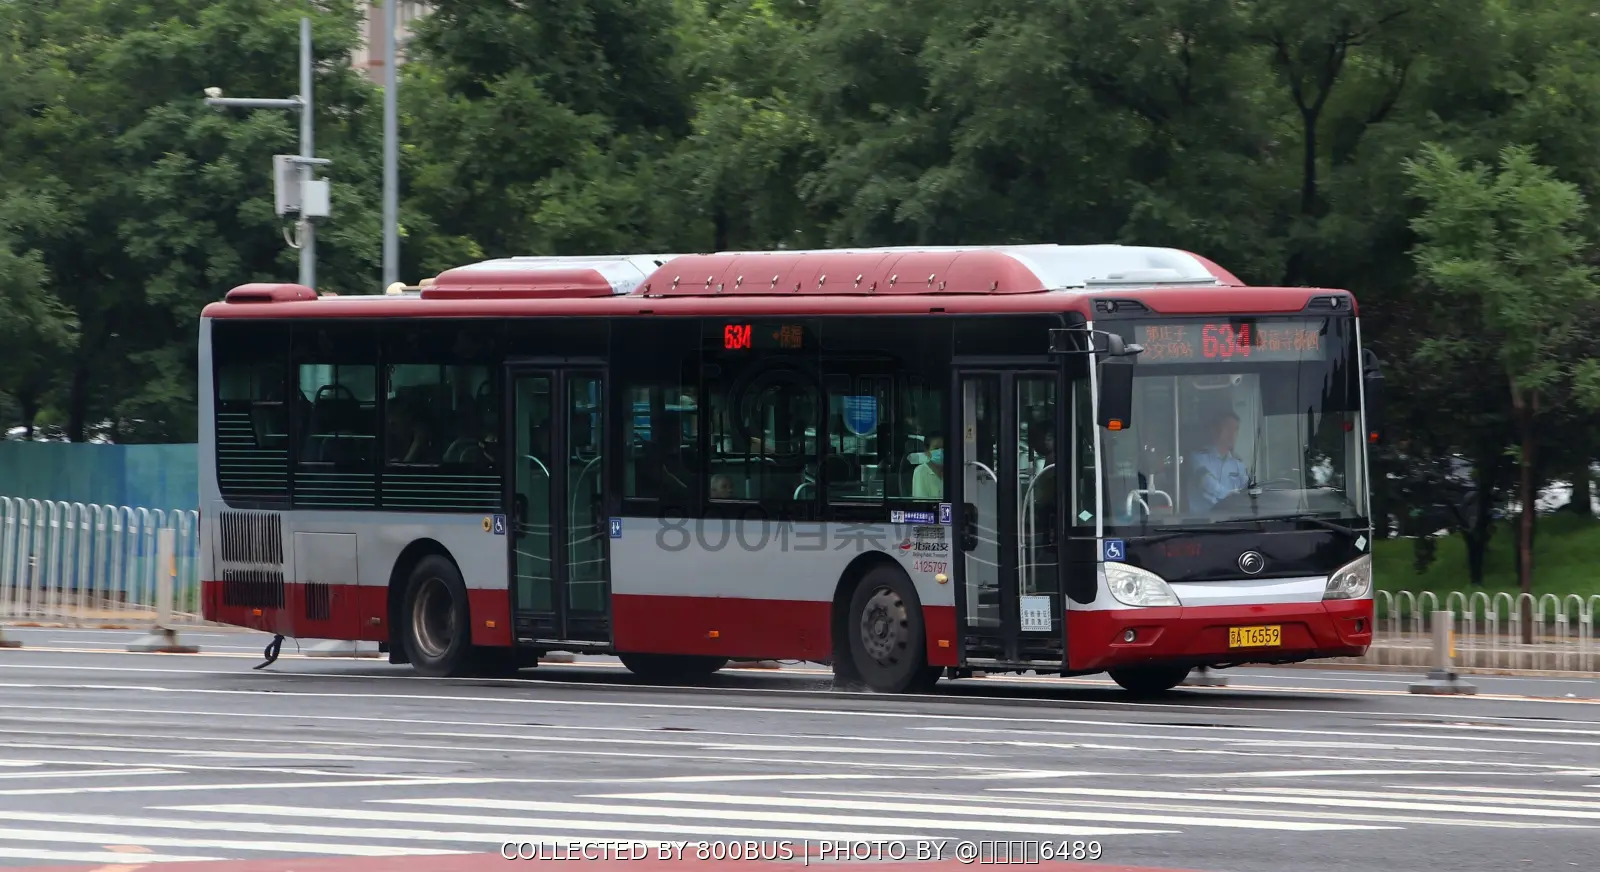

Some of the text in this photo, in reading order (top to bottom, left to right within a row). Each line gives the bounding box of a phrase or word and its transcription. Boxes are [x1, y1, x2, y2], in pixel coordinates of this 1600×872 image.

[725, 324, 751, 348] 634
[1202, 323, 1251, 358] 634
[913, 542, 949, 552] 北京公交
[914, 560, 948, 573] 4125797
